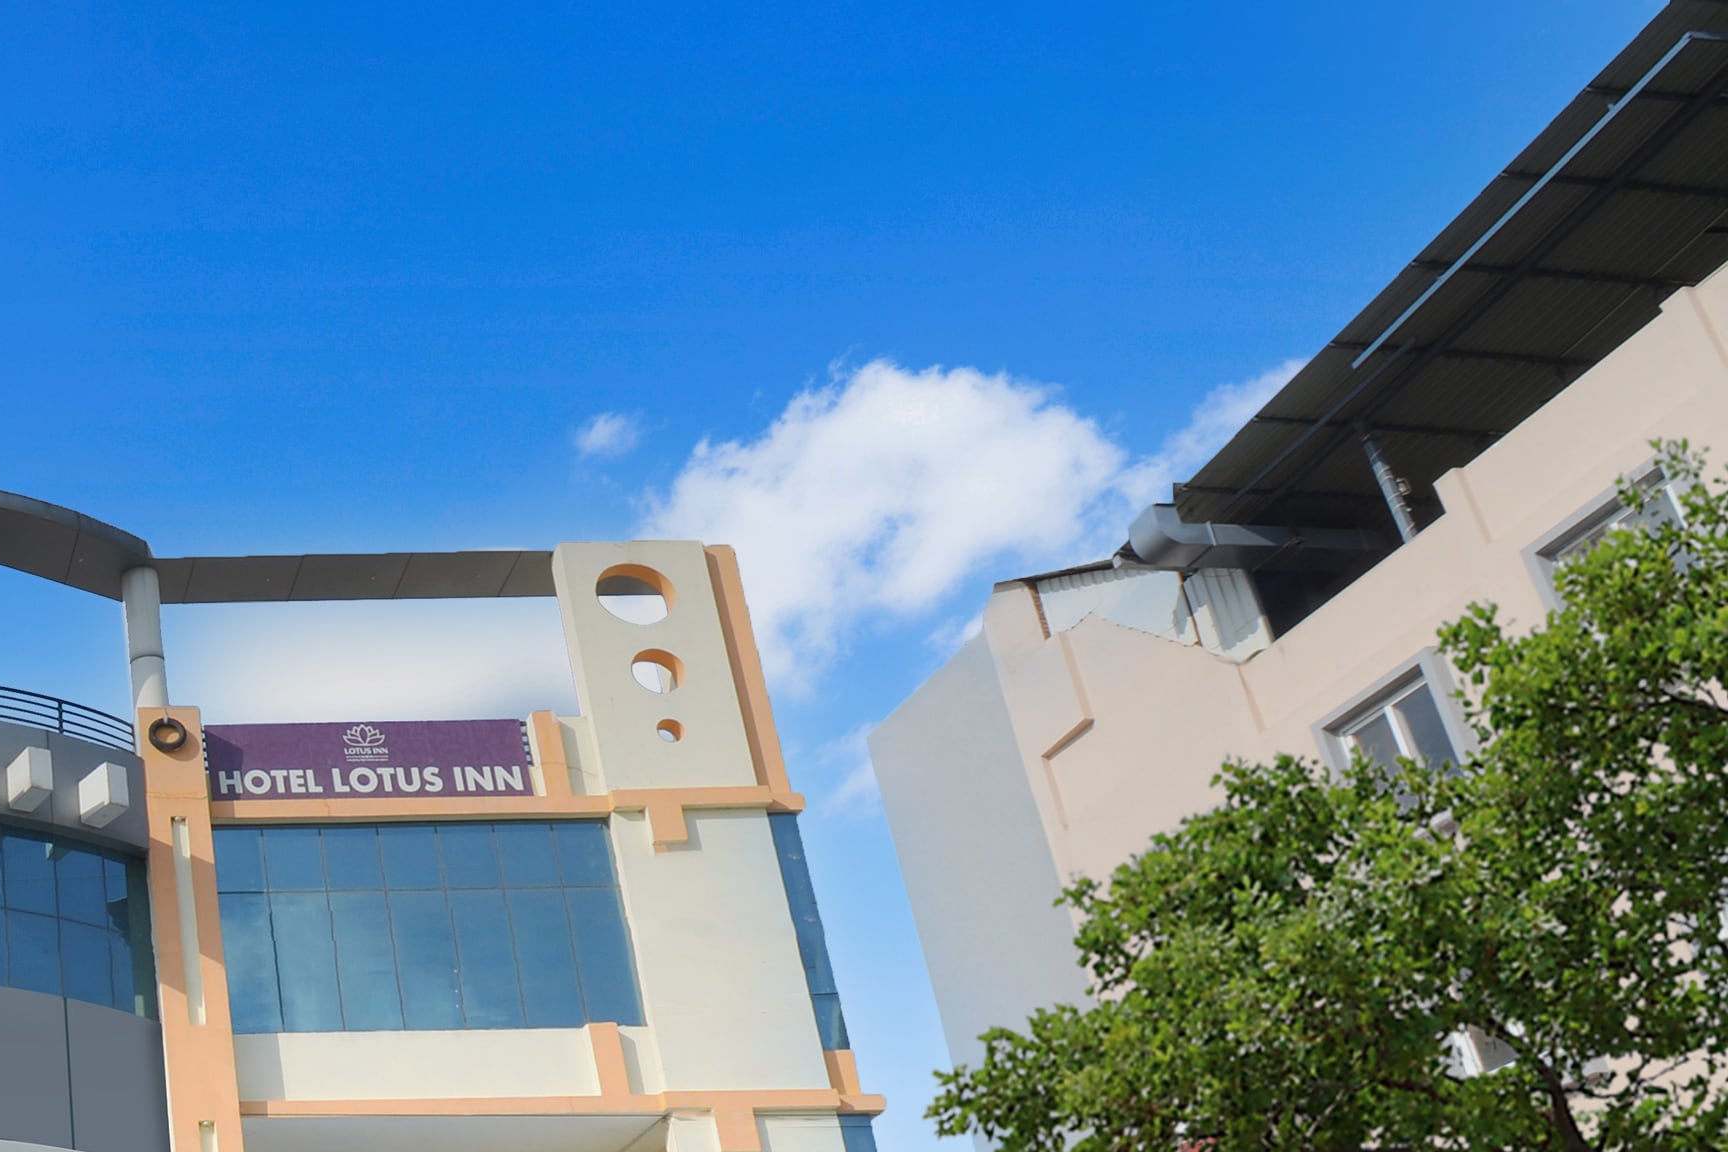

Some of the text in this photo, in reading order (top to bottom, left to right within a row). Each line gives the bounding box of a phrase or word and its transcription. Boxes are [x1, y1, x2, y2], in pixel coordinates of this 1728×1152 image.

[344, 747, 389, 755] LOTUS INN
[218, 765, 524, 795] HOTEL LOTUS INN
